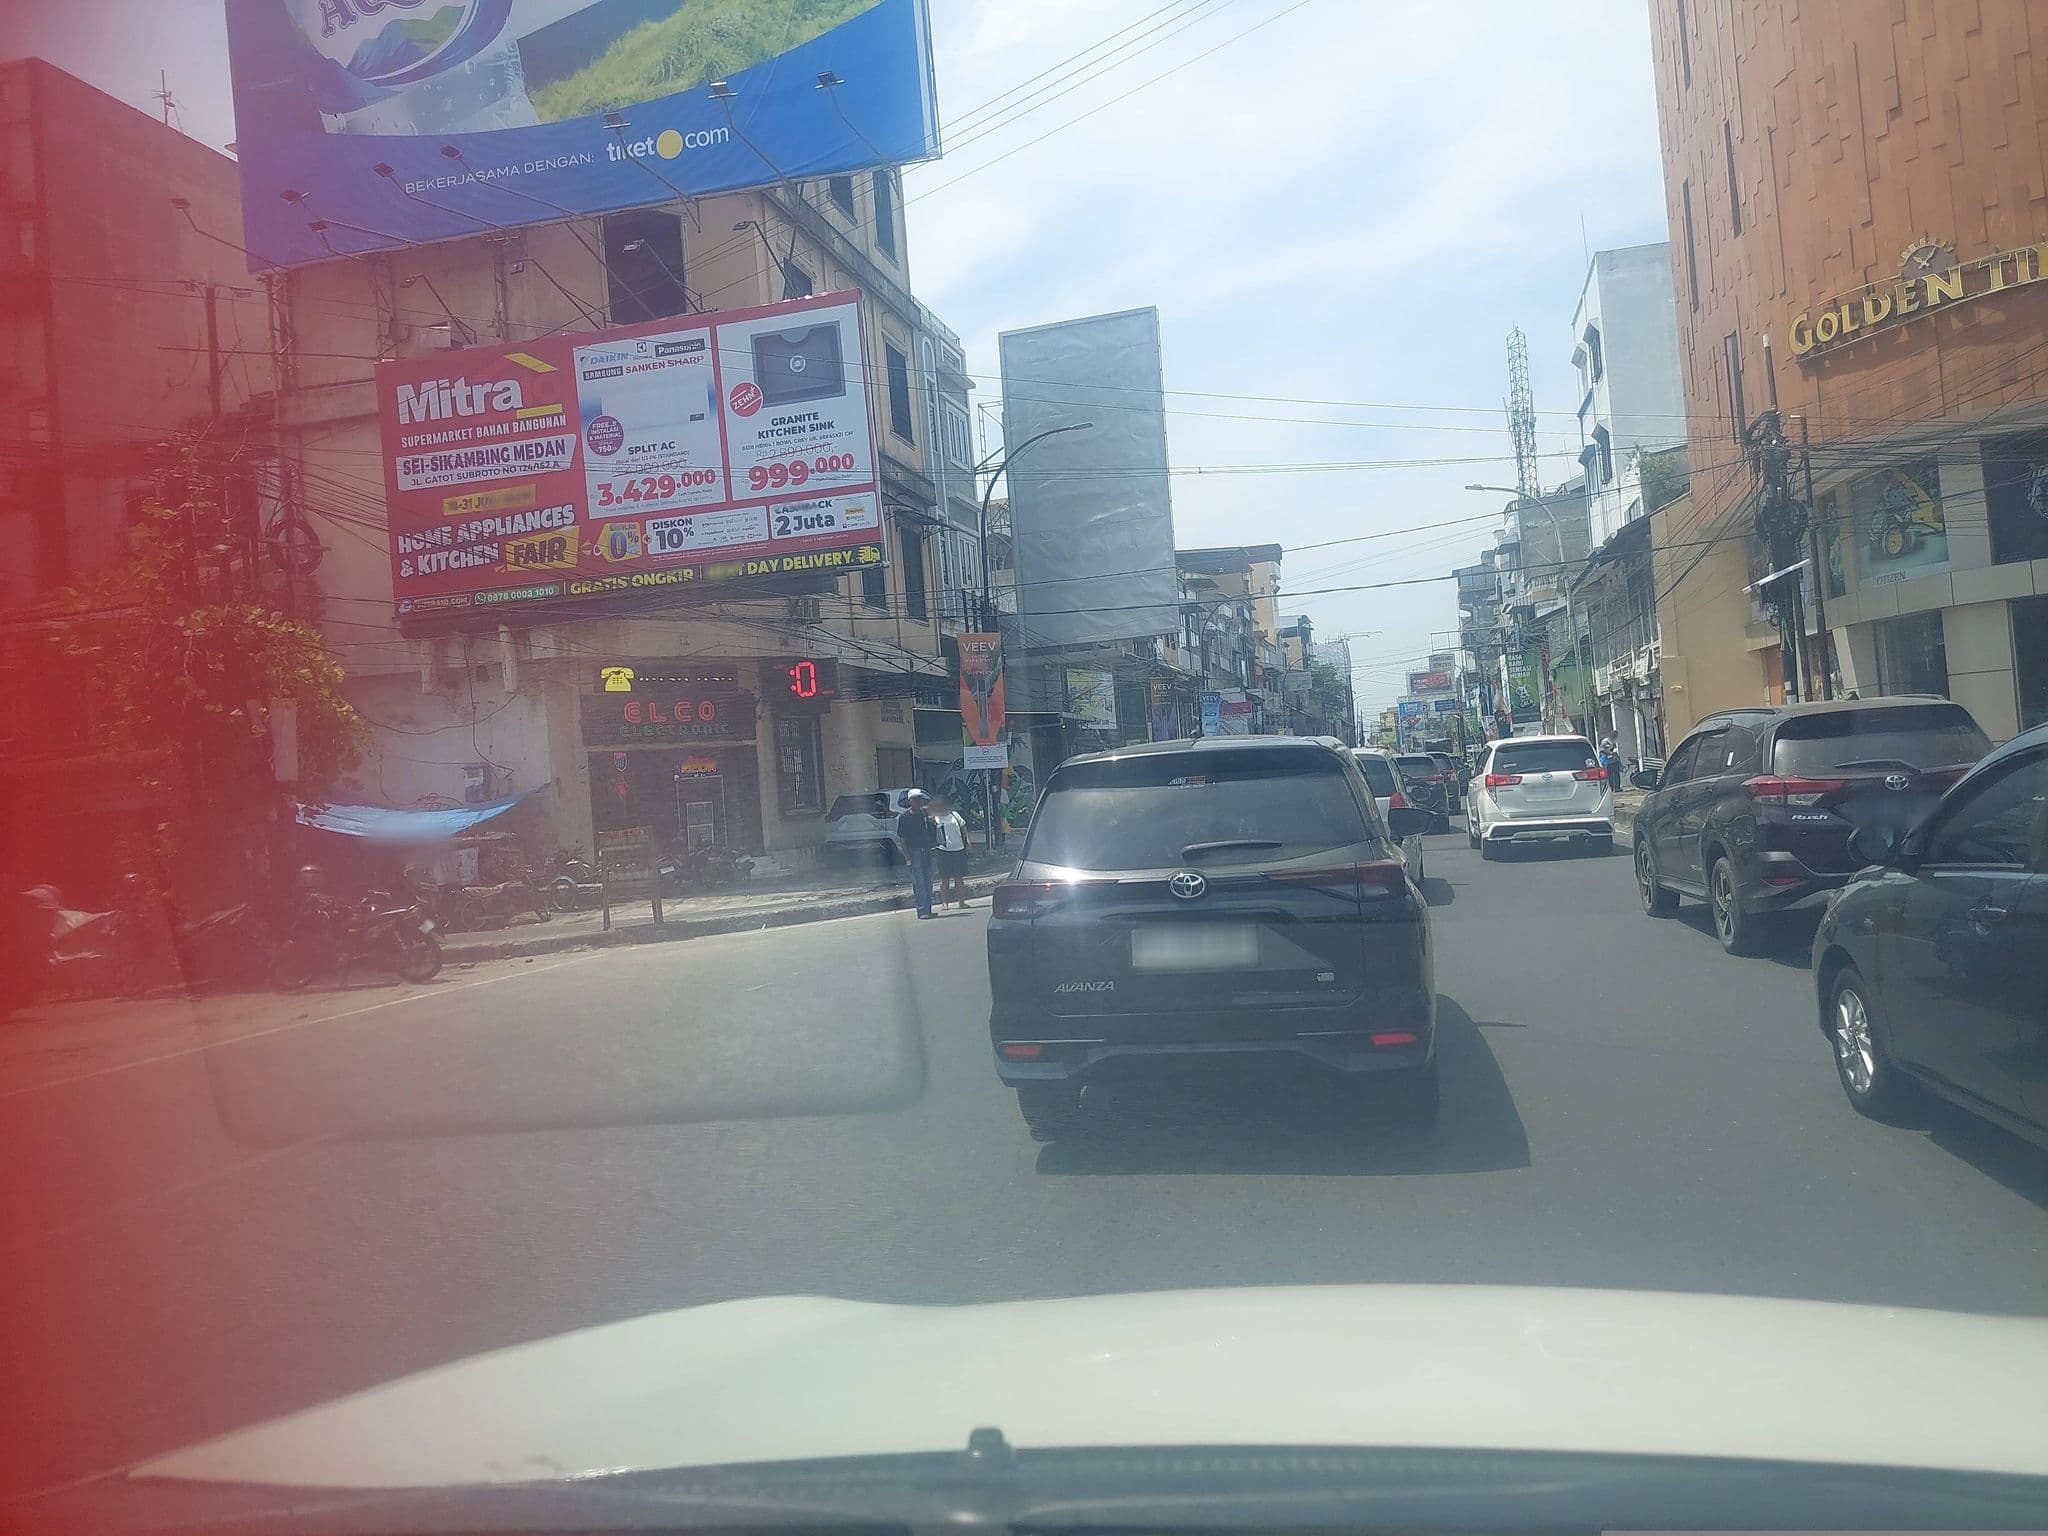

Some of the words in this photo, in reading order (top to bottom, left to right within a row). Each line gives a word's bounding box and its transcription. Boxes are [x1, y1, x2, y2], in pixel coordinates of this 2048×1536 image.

[405, 165, 520, 194] BEKERJASAMA
[523, 153, 595, 174] DENGAN:
[1788, 264, 1964, 355] GOLDEN
[590, 353, 629, 365] DAIKIN
[658, 342, 702, 354] Panasonic
[584, 366, 622, 380] SAMSUNG
[625, 361, 666, 374] SANKEN
[667, 355, 705, 368] SHARP
[397, 376, 524, 425] Mitra
[758, 425, 806, 439] KITCHEN
[808, 420, 835, 433] SINK
[771, 412, 819, 427] GRANITE
[401, 428, 473, 448] SUPERMARKET
[476, 423, 510, 438] BAHAN
[512, 415, 567, 433] BANGUNAN
[403, 446, 511, 476] SEI-SIKAMBING
[514, 439, 566, 461] MEDAN
[628, 443, 657, 455] SPLIT
[660, 441, 675, 451] AC
[411, 478, 423, 487] JL.
[424, 474, 454, 485] GATOT
[456, 468, 501, 481] SUBROTO
[503, 465, 517, 474] NO
[748, 453, 855, 491] 999.000
[597, 469, 716, 506] 3.429.000
[399, 525, 453, 554] HOME
[456, 504, 576, 543] APPLIANCES
[652, 518, 692, 530] DISKON
[776, 515, 791, 536] 2
[793, 514, 835, 532] Juta
[656, 527, 695, 550] 10%
[400, 559, 414, 578] &
[418, 543, 499, 576] KITCHEN
[513, 536, 568, 566] FAIR
[747, 559, 779, 575] DAY
[783, 550, 853, 571] DELIVERY
[535, 587, 555, 596] 1010
[570, 576, 628, 595] GRATIS
[631, 568, 694, 587] ONGKIR
[962, 641, 996, 652] VEEV
[1153, 683, 1172, 691] VEEV
[624, 701, 715, 723] ELCO
[1054, 981, 1114, 993] AVANZA
